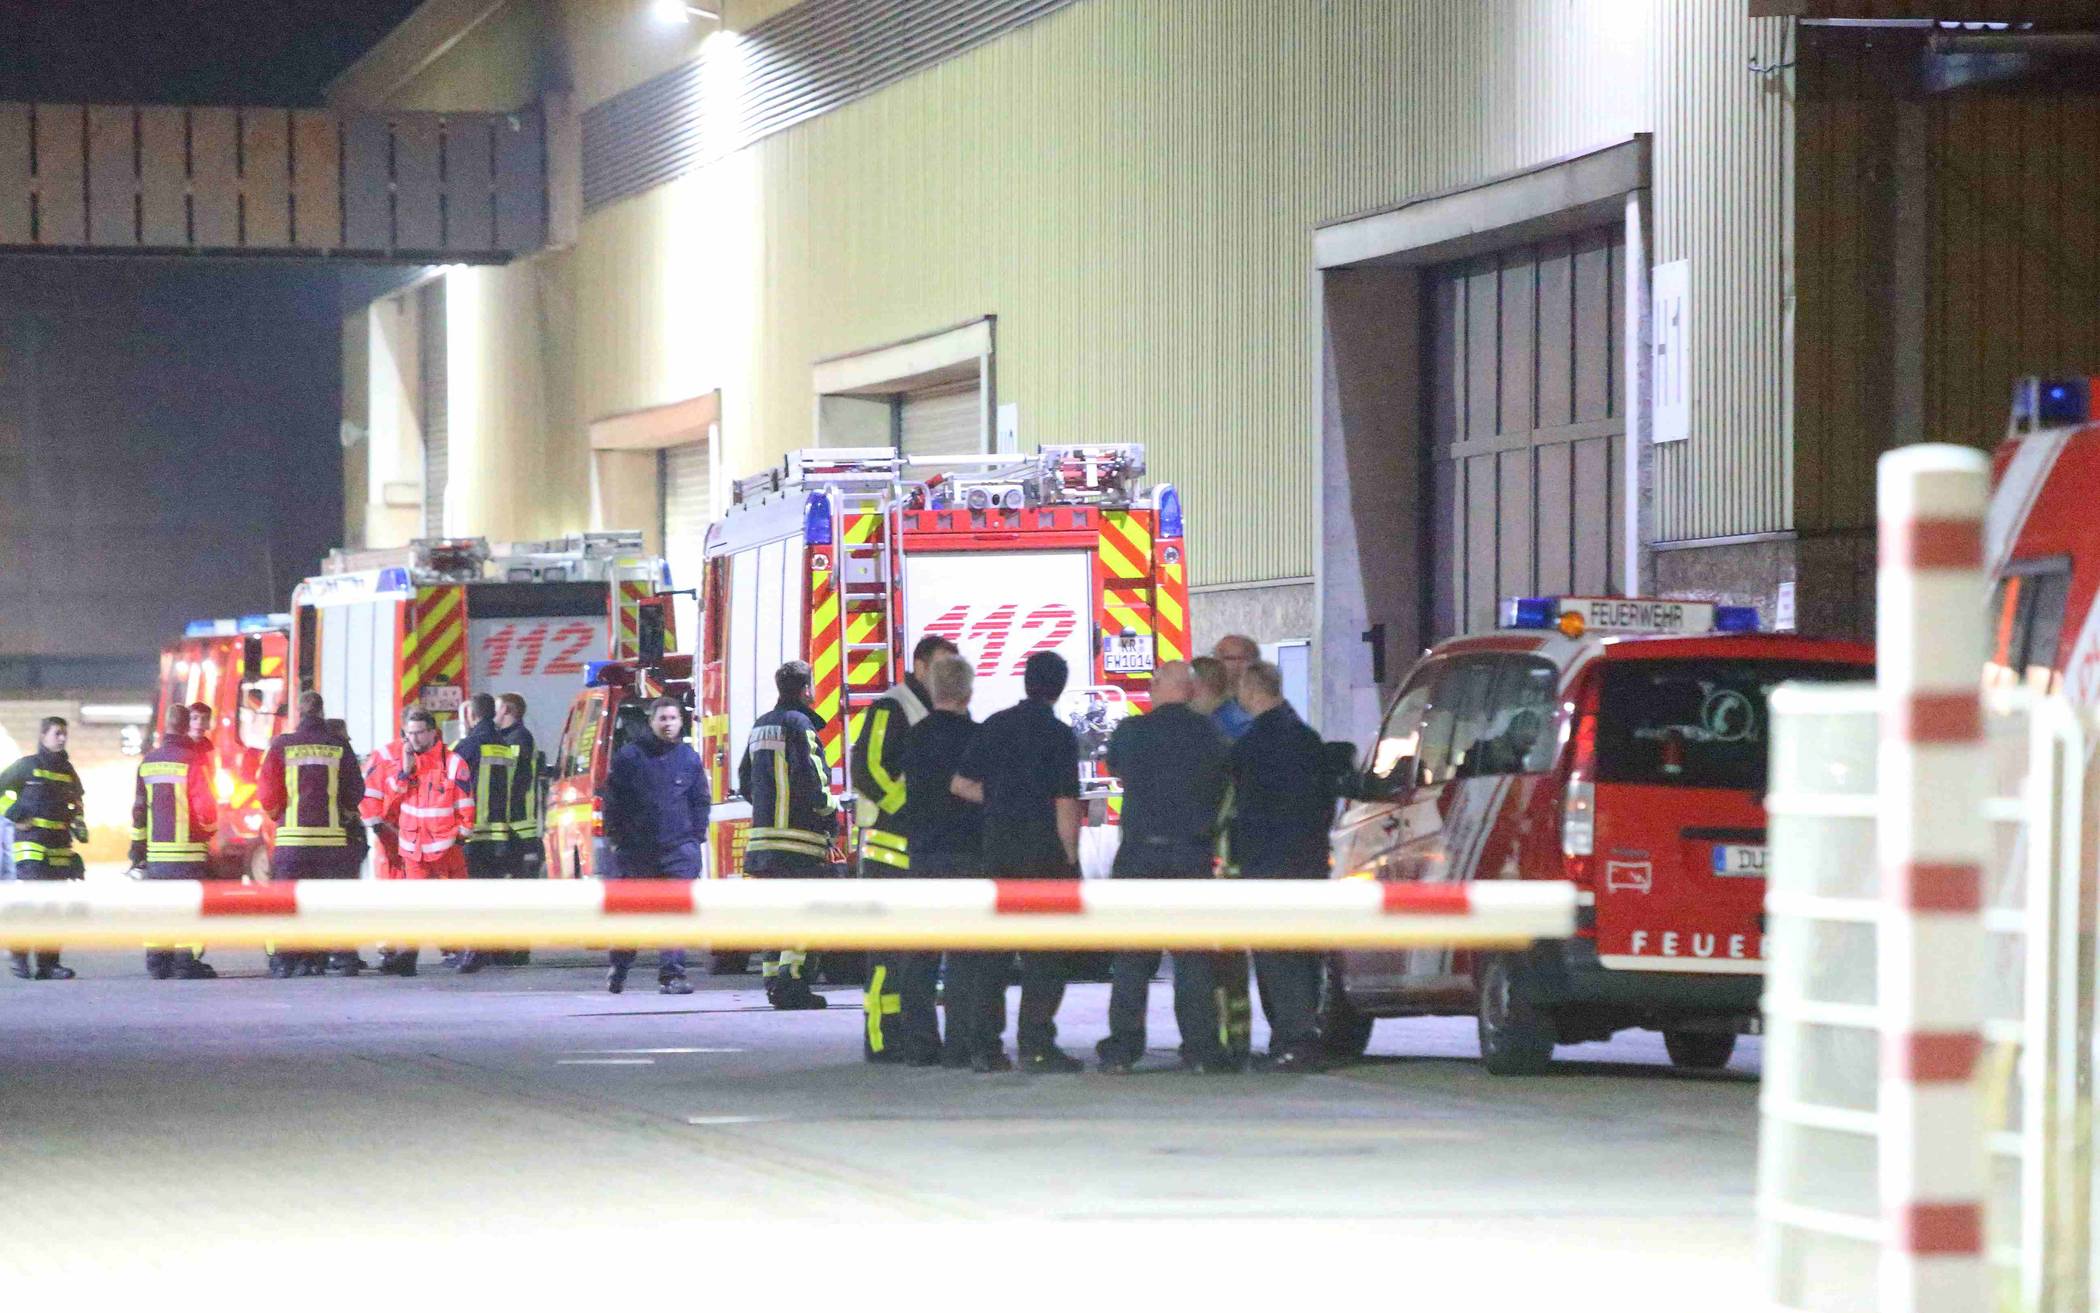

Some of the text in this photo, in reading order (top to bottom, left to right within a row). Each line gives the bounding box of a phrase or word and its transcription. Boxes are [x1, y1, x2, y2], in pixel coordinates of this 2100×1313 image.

[1591, 603, 1684, 627] FEUERWEHR
[483, 622, 594, 676] 112
[1631, 930, 1767, 958] FEUE
